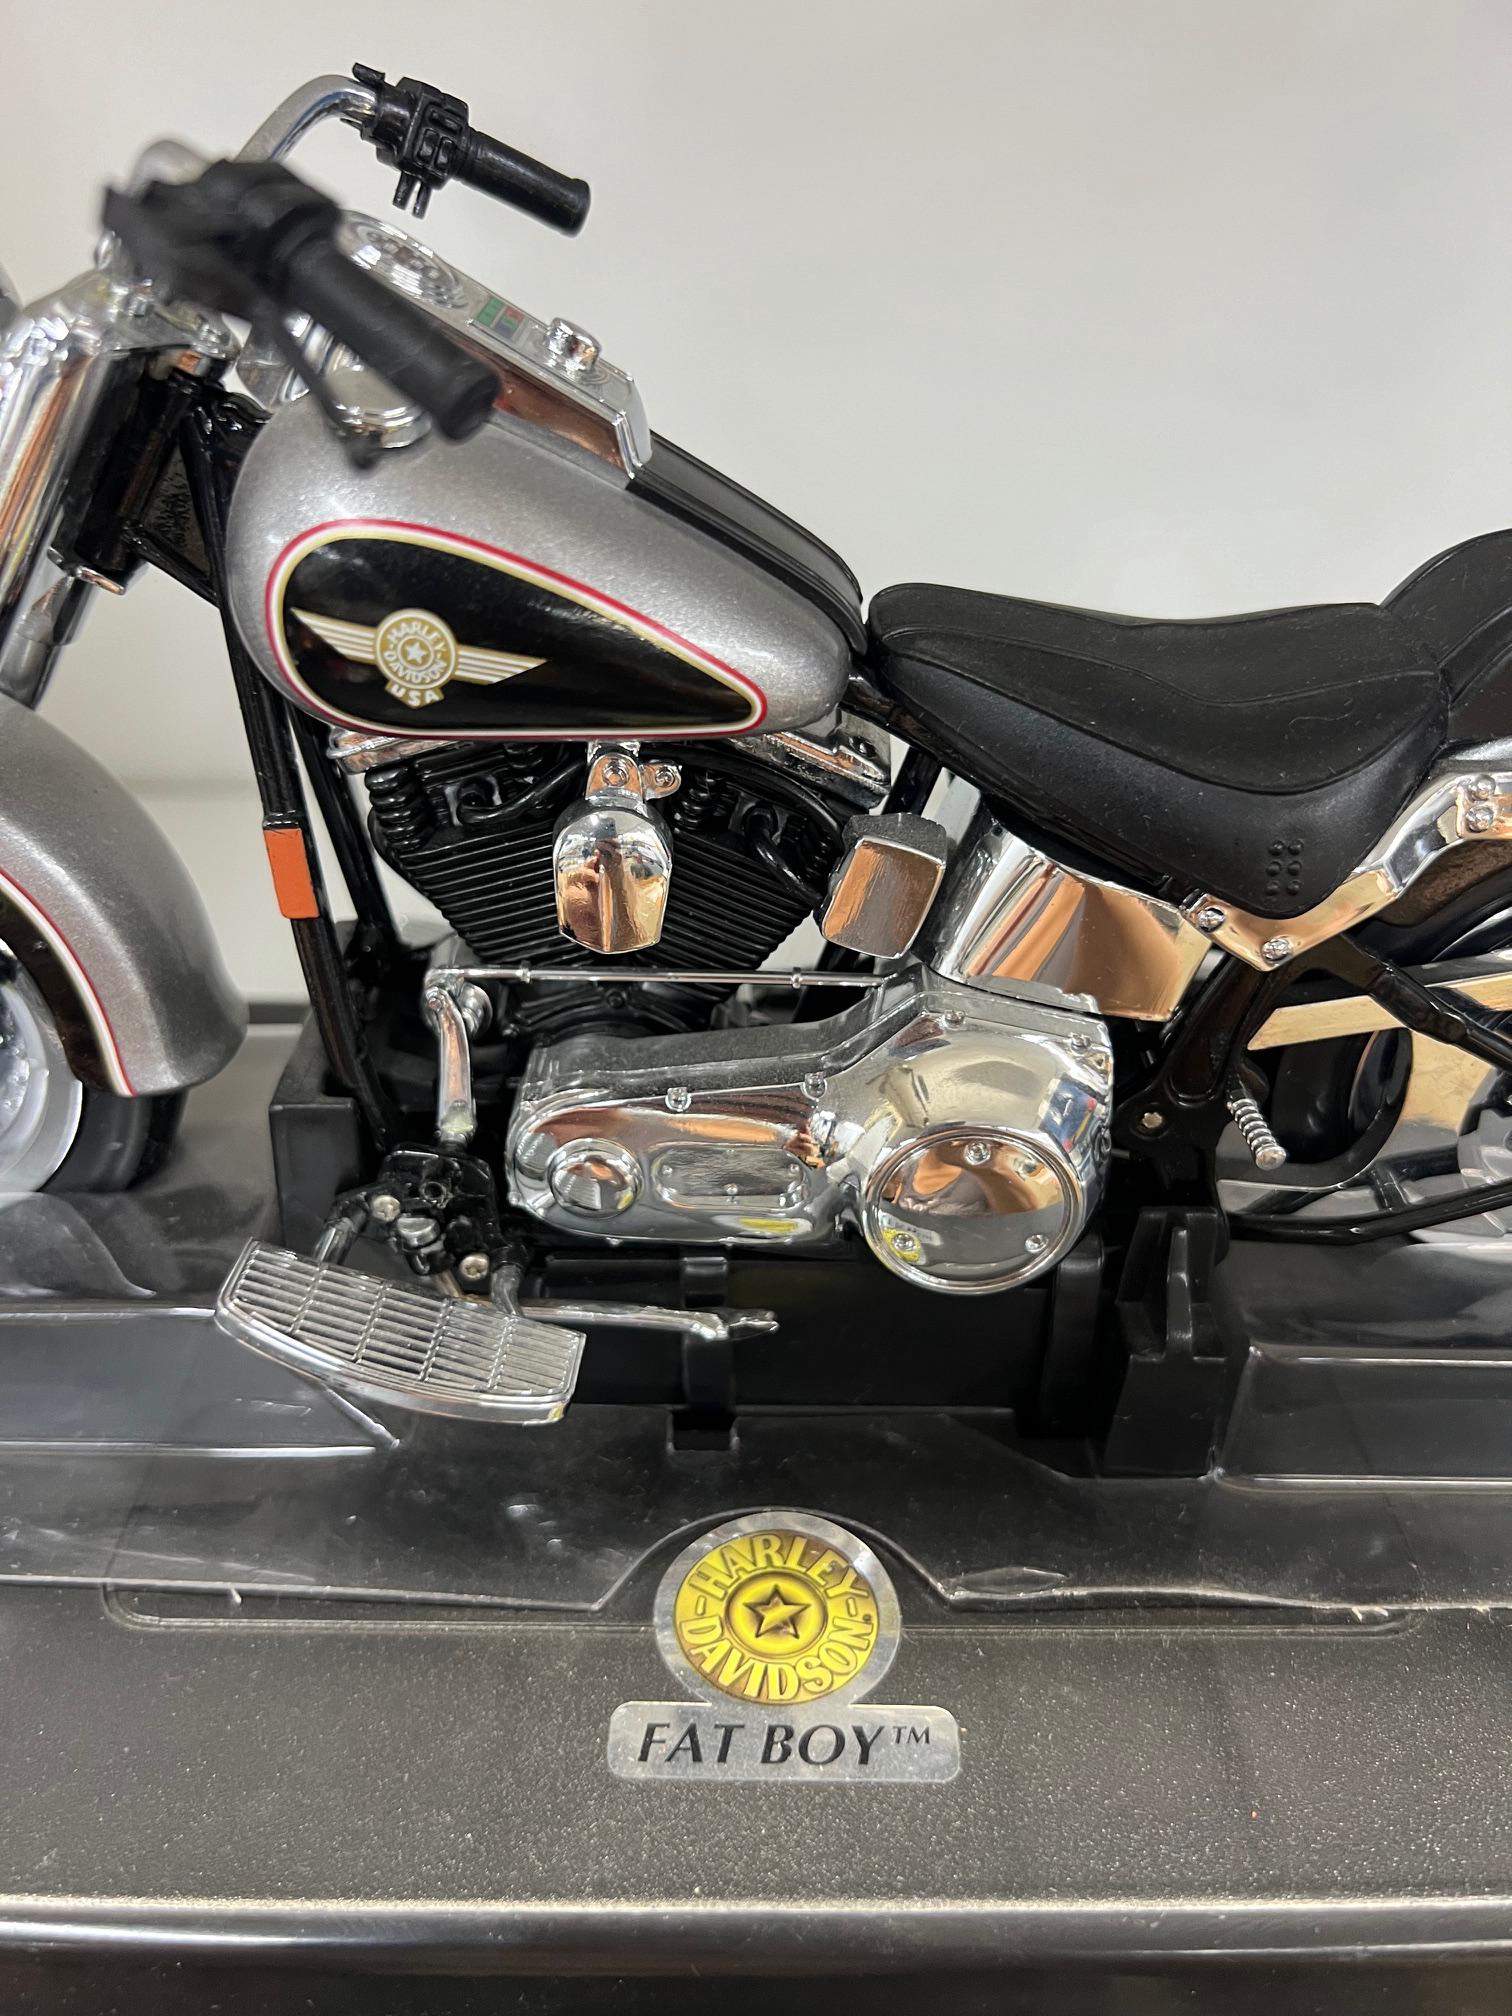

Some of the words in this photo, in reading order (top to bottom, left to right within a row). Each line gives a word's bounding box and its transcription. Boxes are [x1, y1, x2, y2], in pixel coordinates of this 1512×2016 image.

[387, 621, 447, 652] HARLEY
[384, 651, 447, 683] DAVIDSON
[391, 684, 440, 706] USA
[688, 1533, 869, 1600] HARLEY
[679, 1615, 874, 1700] DAVIDSON
[637, 1722, 745, 1763] FAT
